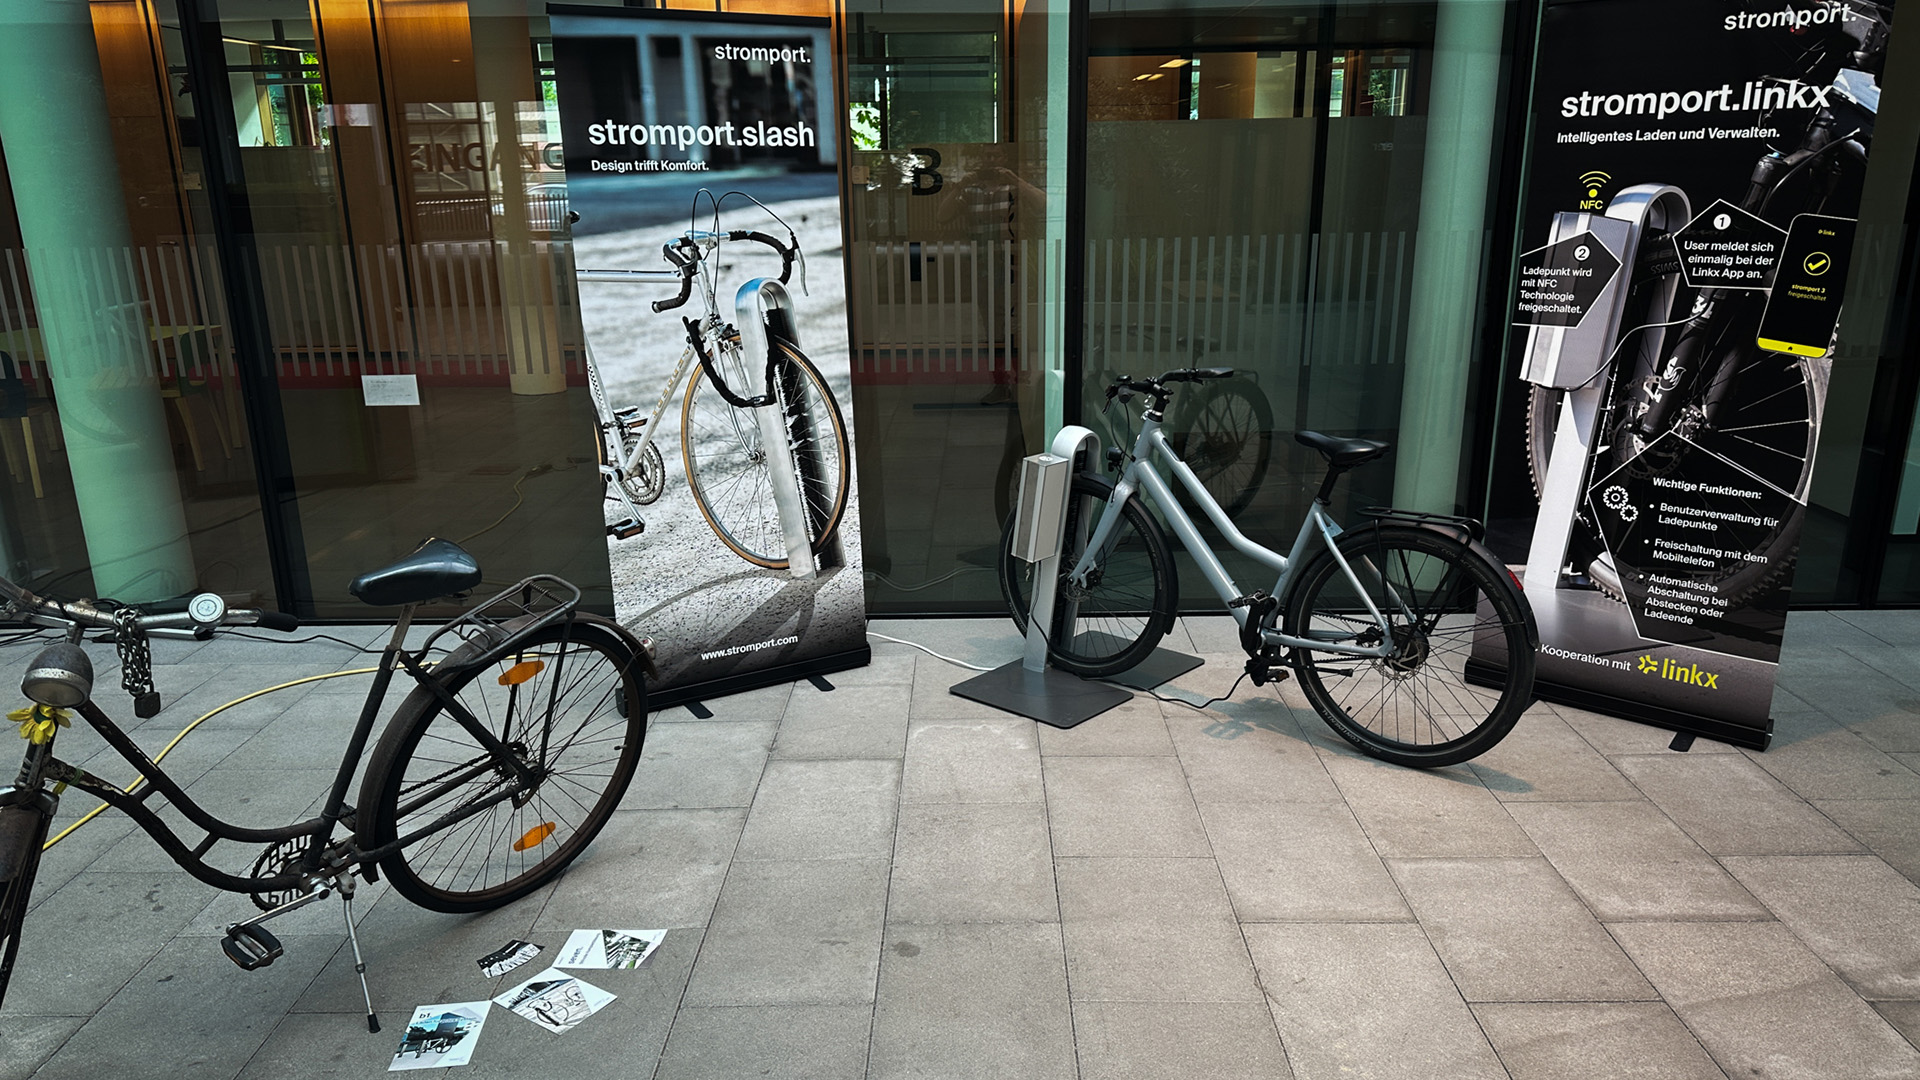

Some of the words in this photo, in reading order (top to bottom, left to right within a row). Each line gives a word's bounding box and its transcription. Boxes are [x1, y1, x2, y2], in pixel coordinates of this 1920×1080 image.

[1723, 4, 1857, 31] stromport.
[714, 43, 811, 65] stromport.
[1561, 80, 1834, 120] stromport.linkx
[588, 119, 815, 151] stromport.slash
[1557, 130, 1633, 145] Intelligentes
[1635, 128, 1677, 142] Laden
[1679, 127, 1705, 141] und
[1708, 126, 1781, 140] Verwalten.
[591, 159, 633, 173] Design
[634, 159, 659, 172] trifft
[660, 159, 710, 172] Komfort.
[911, 147, 943, 196] B
[1579, 200, 1604, 210] NFC
[1684, 240, 1710, 251] User
[1711, 241, 1749, 252] meldet
[1751, 242, 1775, 252] sich
[1688, 254, 1734, 267] einmalig
[1735, 255, 1753, 265] bei
[1754, 255, 1775, 266] der
[1523, 266, 1571, 277] Ladepunkt
[1572, 268, 1593, 277] wird
[1692, 267, 1720, 277] Linkx
[1721, 268, 1740, 280] App
[1746, 270, 1763, 279] an.
[1521, 278, 1536, 288] mit
[1537, 279, 1558, 288] NFC
[1520, 290, 1575, 303] Technologie
[1518, 302, 1583, 314] freigeschaltet.
[1652, 477, 1698, 492] Wichtige
[1699, 483, 1762, 500] Funktionen:
[1658, 514, 1718, 532] Ladepunkte
[1660, 502, 1761, 527] Benutzerverwaltung
[1763, 516, 1779, 528] für
[1652, 550, 1715, 568] Mobiltelefon
[1654, 538, 1722, 558] Freischaltung
[1724, 549, 1742, 561] mit
[1743, 552, 1768, 564] dem
[1649, 573, 1719, 593] Automatische
[1647, 584, 1709, 605] Abschaltung
[1711, 595, 1728, 607] bei
[1644, 607, 1694, 625] Ladeende
[1645, 596, 1698, 614] Abstecken
[1700, 606, 1724, 619] oder
[701, 634, 798, 661] www.stromport.com
[1541, 644, 1610, 668] Kooperation
[1611, 657, 1631, 672] mit
[1661, 657, 1719, 690] linkx
